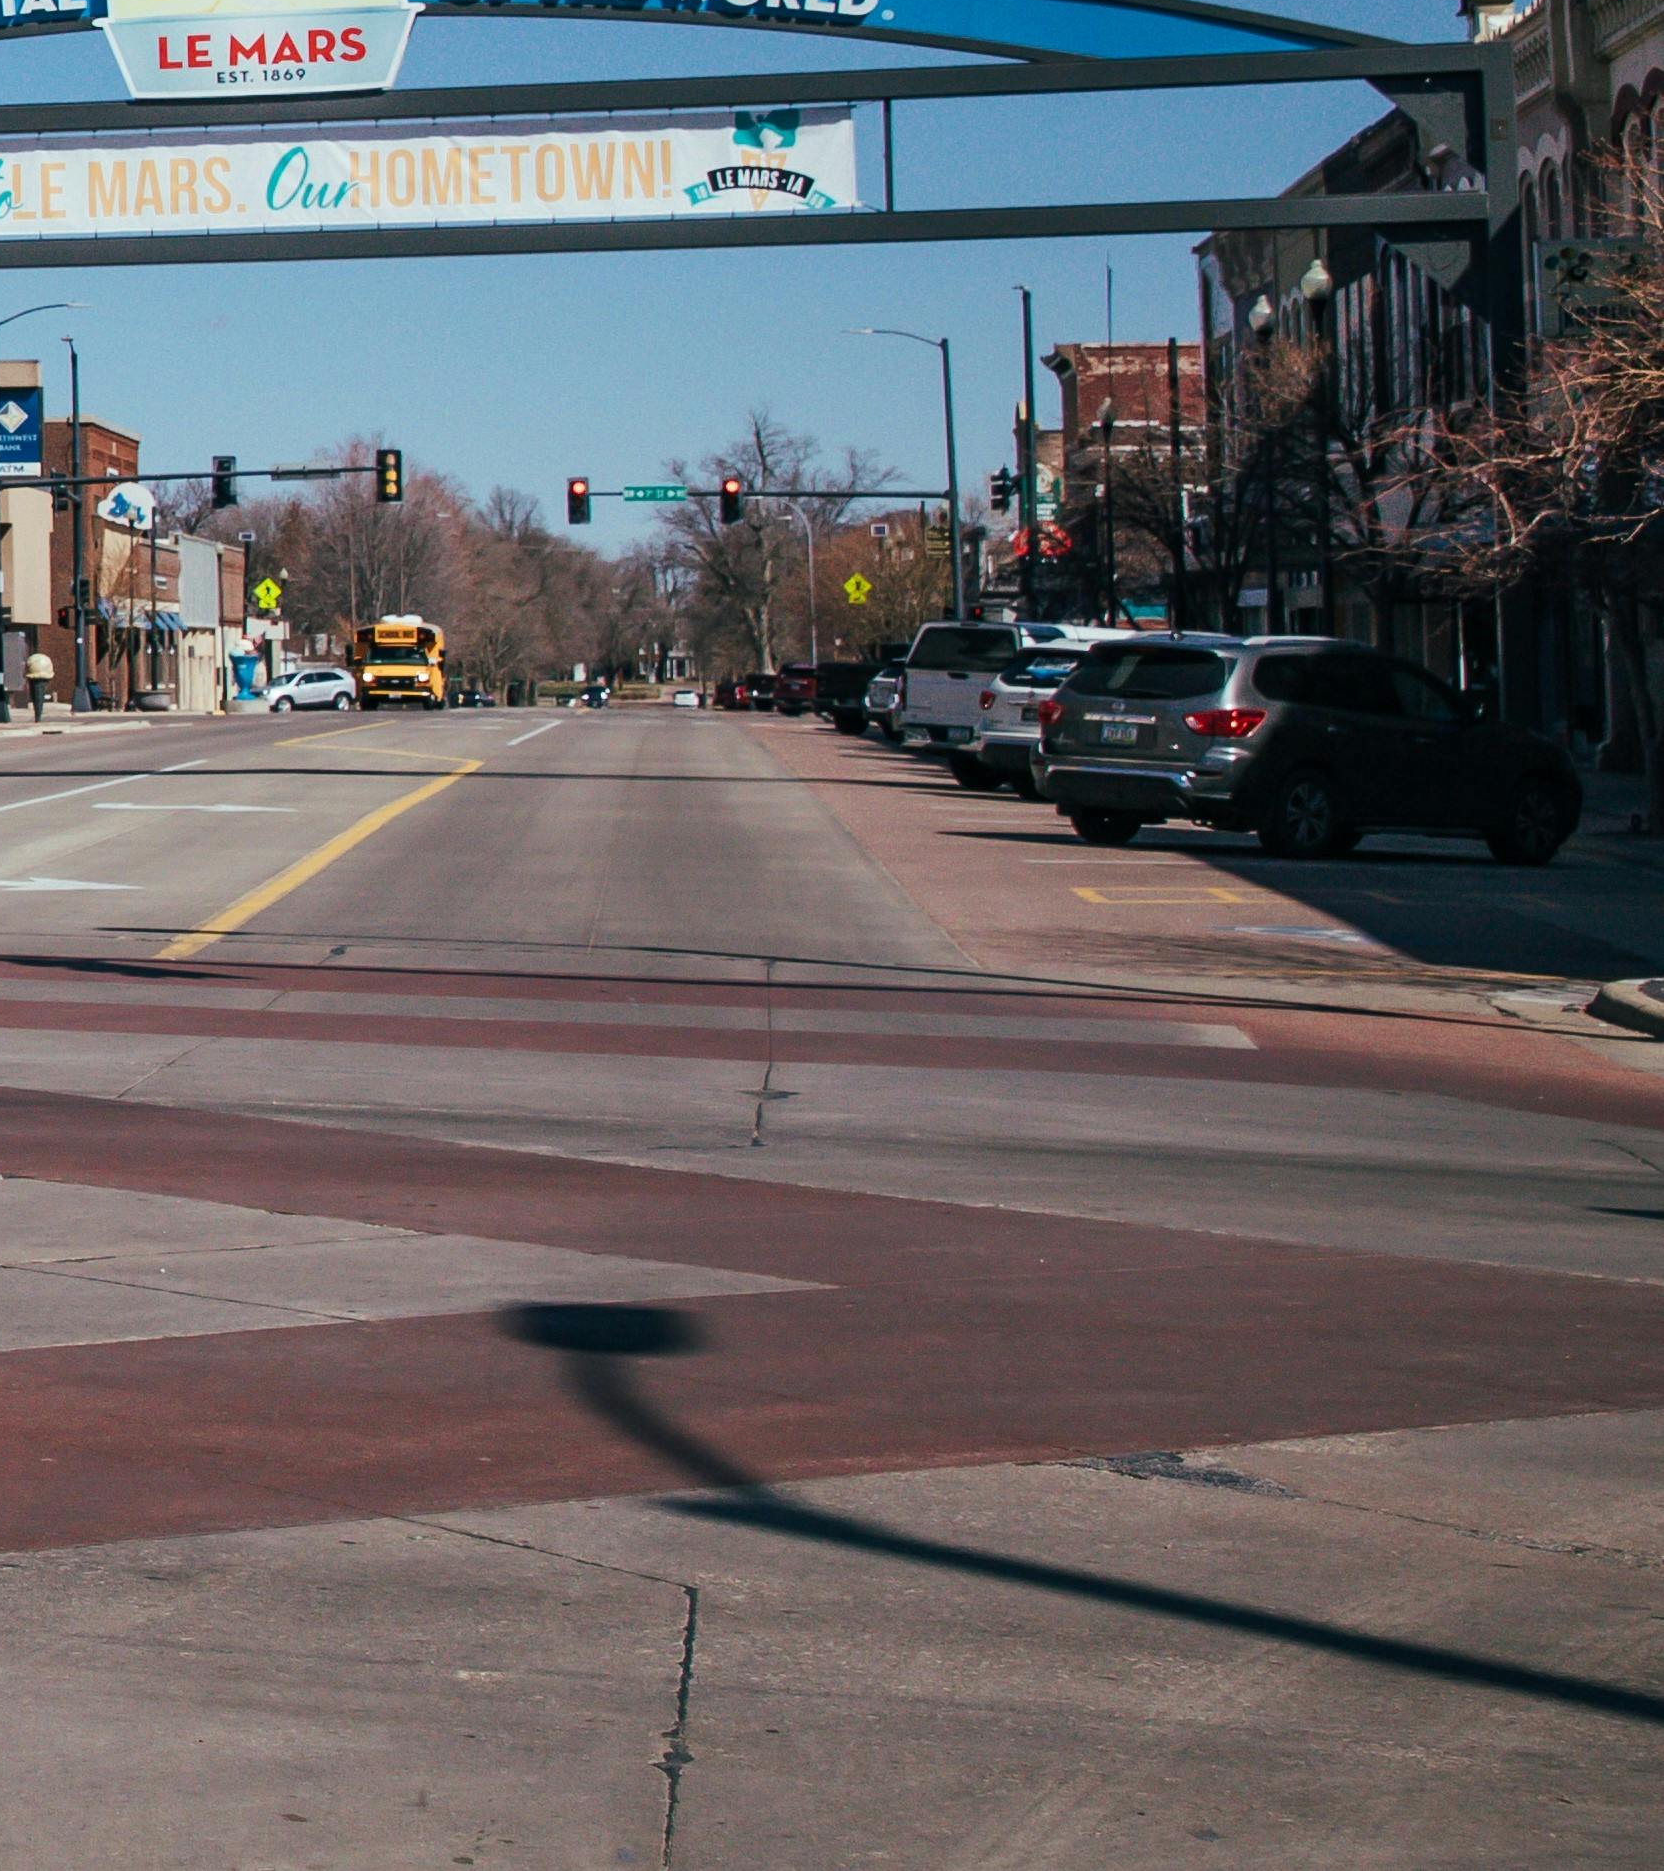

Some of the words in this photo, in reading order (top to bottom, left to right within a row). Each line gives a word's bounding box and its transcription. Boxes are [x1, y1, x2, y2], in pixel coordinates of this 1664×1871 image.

[159, 34, 212, 70] LE
[229, 27, 366, 67] MARS
[216, 70, 256, 84] EST.
[262, 68, 307, 83] 1869
[12, 162, 65, 221] LE
[87, 157, 246, 219] MARS.
[266, 146, 360, 212] Our
[350, 139, 672, 209] HOMETOWN!
[716, 170, 734, 188] LE
